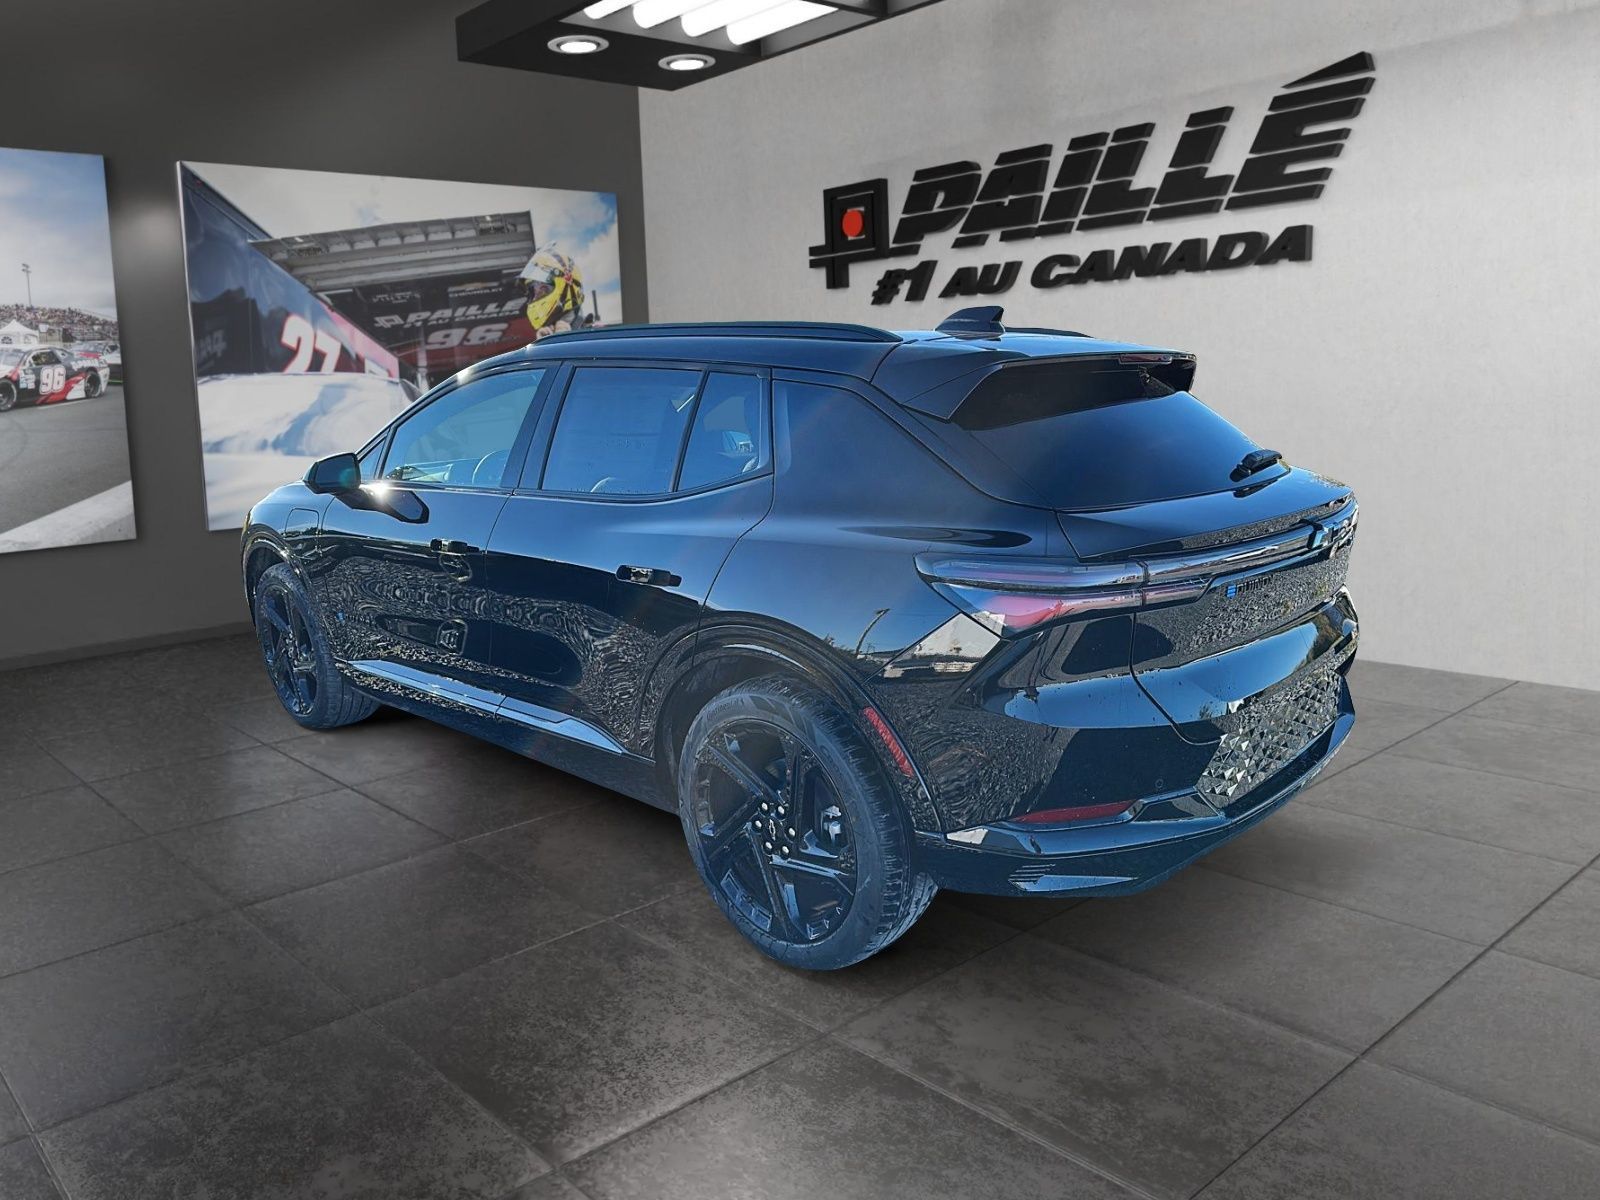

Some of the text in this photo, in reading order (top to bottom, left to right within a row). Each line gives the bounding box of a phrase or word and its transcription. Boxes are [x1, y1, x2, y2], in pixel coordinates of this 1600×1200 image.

[889, 51, 1375, 257] PAILLÉ
[871, 224, 1313, 305] #1 AU CANADA
[281, 314, 342, 373] 27
[425, 323, 509, 350] 96
[39, 365, 66, 395] 96
